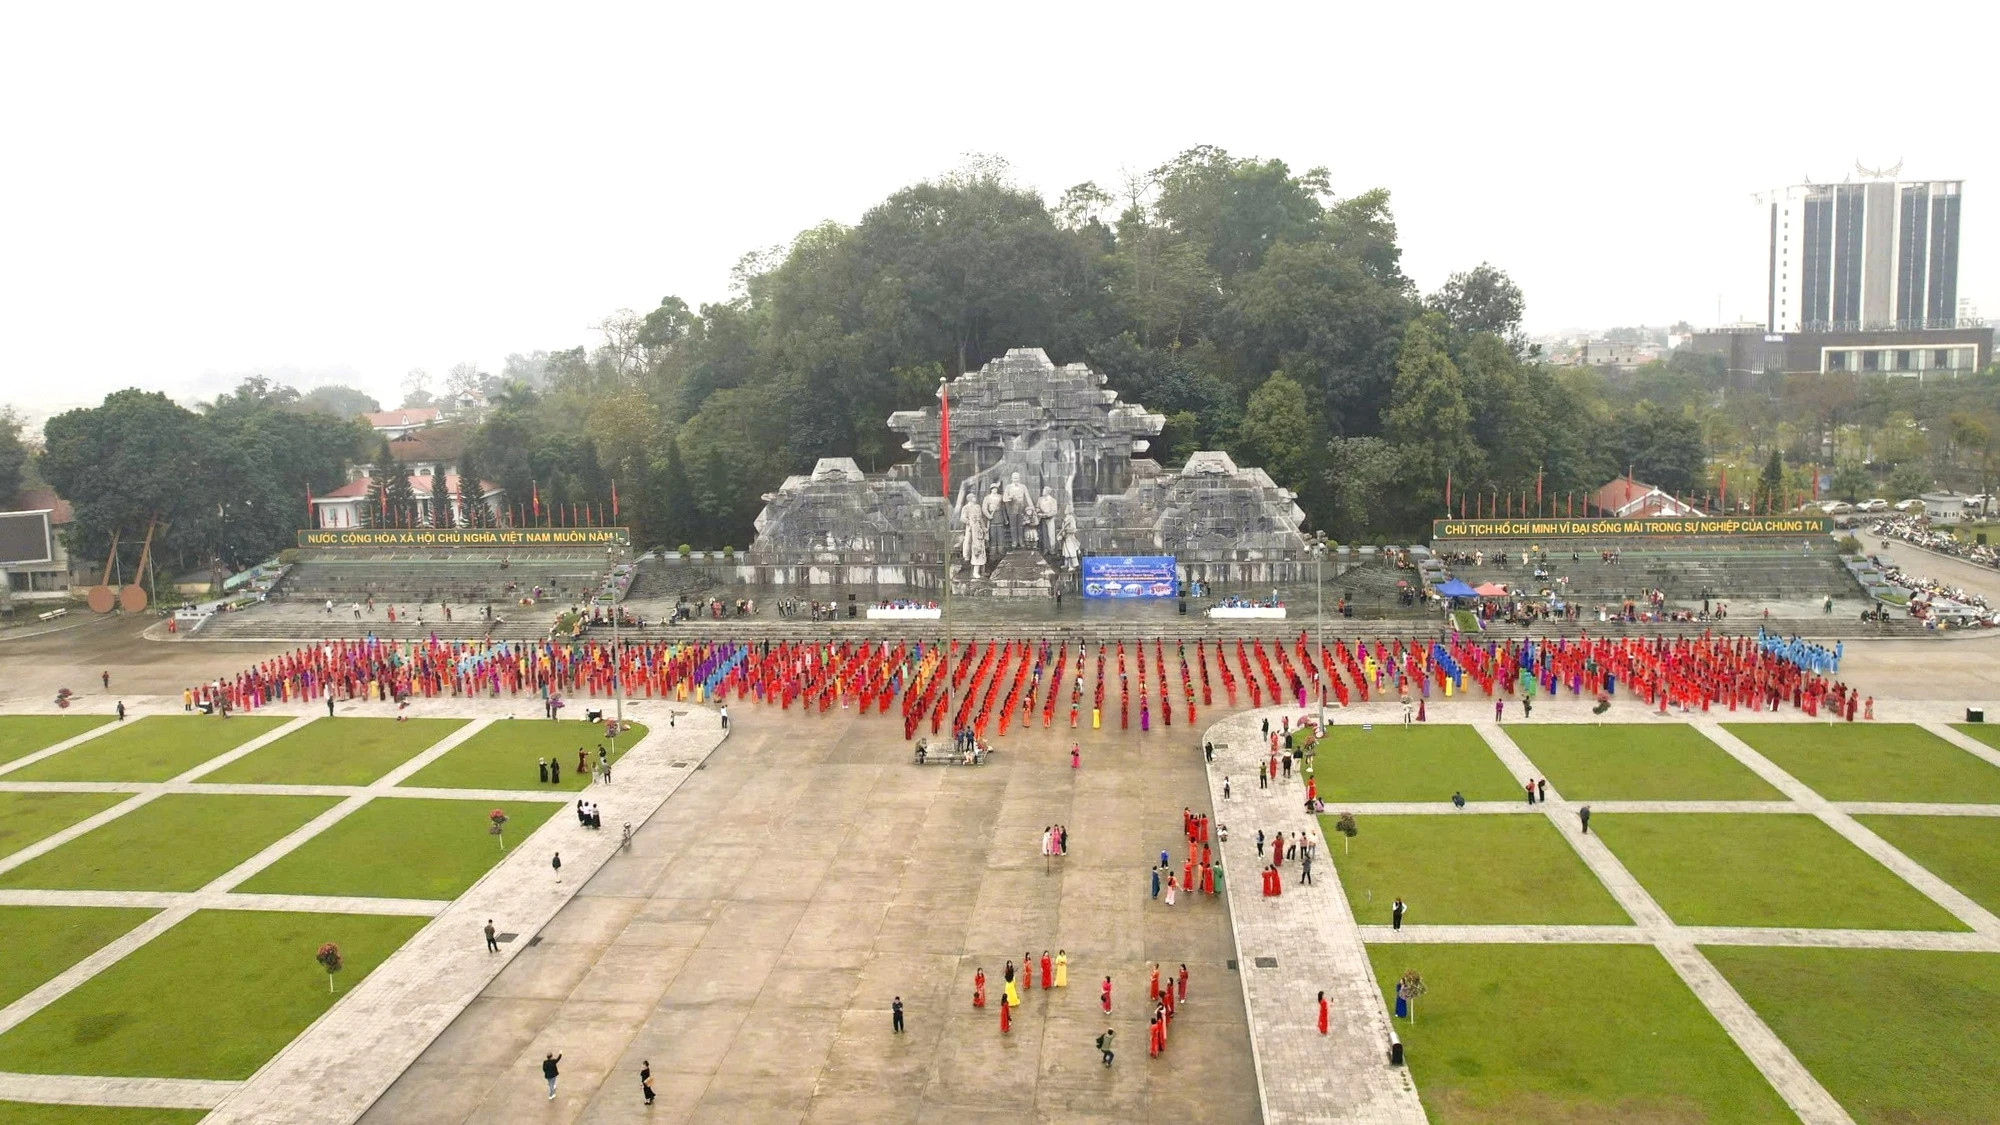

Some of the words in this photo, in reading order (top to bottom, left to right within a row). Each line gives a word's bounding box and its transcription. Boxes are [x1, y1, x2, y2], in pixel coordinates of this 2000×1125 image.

[1445, 522, 1466, 534] CHỦ
[1470, 524, 1492, 536] TỊCH
[1512, 522, 1530, 534] CHÍ
[1532, 524, 1558, 534] MINH
[1560, 522, 1570, 533] VĨ
[1572, 524, 1590, 535] ĐẠI
[1592, 520, 1622, 532] SỐNG
[1624, 520, 1642, 532] MÃI
[1645, 522, 1682, 532] TRONG
[1684, 521, 1699, 534] SỰ
[1701, 520, 1740, 534] NGHIỆP
[1742, 518, 1764, 531] CỦA
[1765, 518, 1802, 531] CHÚNG
[308, 532, 338, 543] NƯỚC
[342, 532, 372, 545] CỘNG
[374, 532, 397, 542] HÒA
[417, 532, 435, 544] HỘI
[438, 530, 460, 542] CHỦ
[464, 531, 497, 542] NGHĨA
[500, 530, 524, 544] VIỆT
[526, 532, 550, 542] NAM
[554, 530, 586, 542] MUÔN
